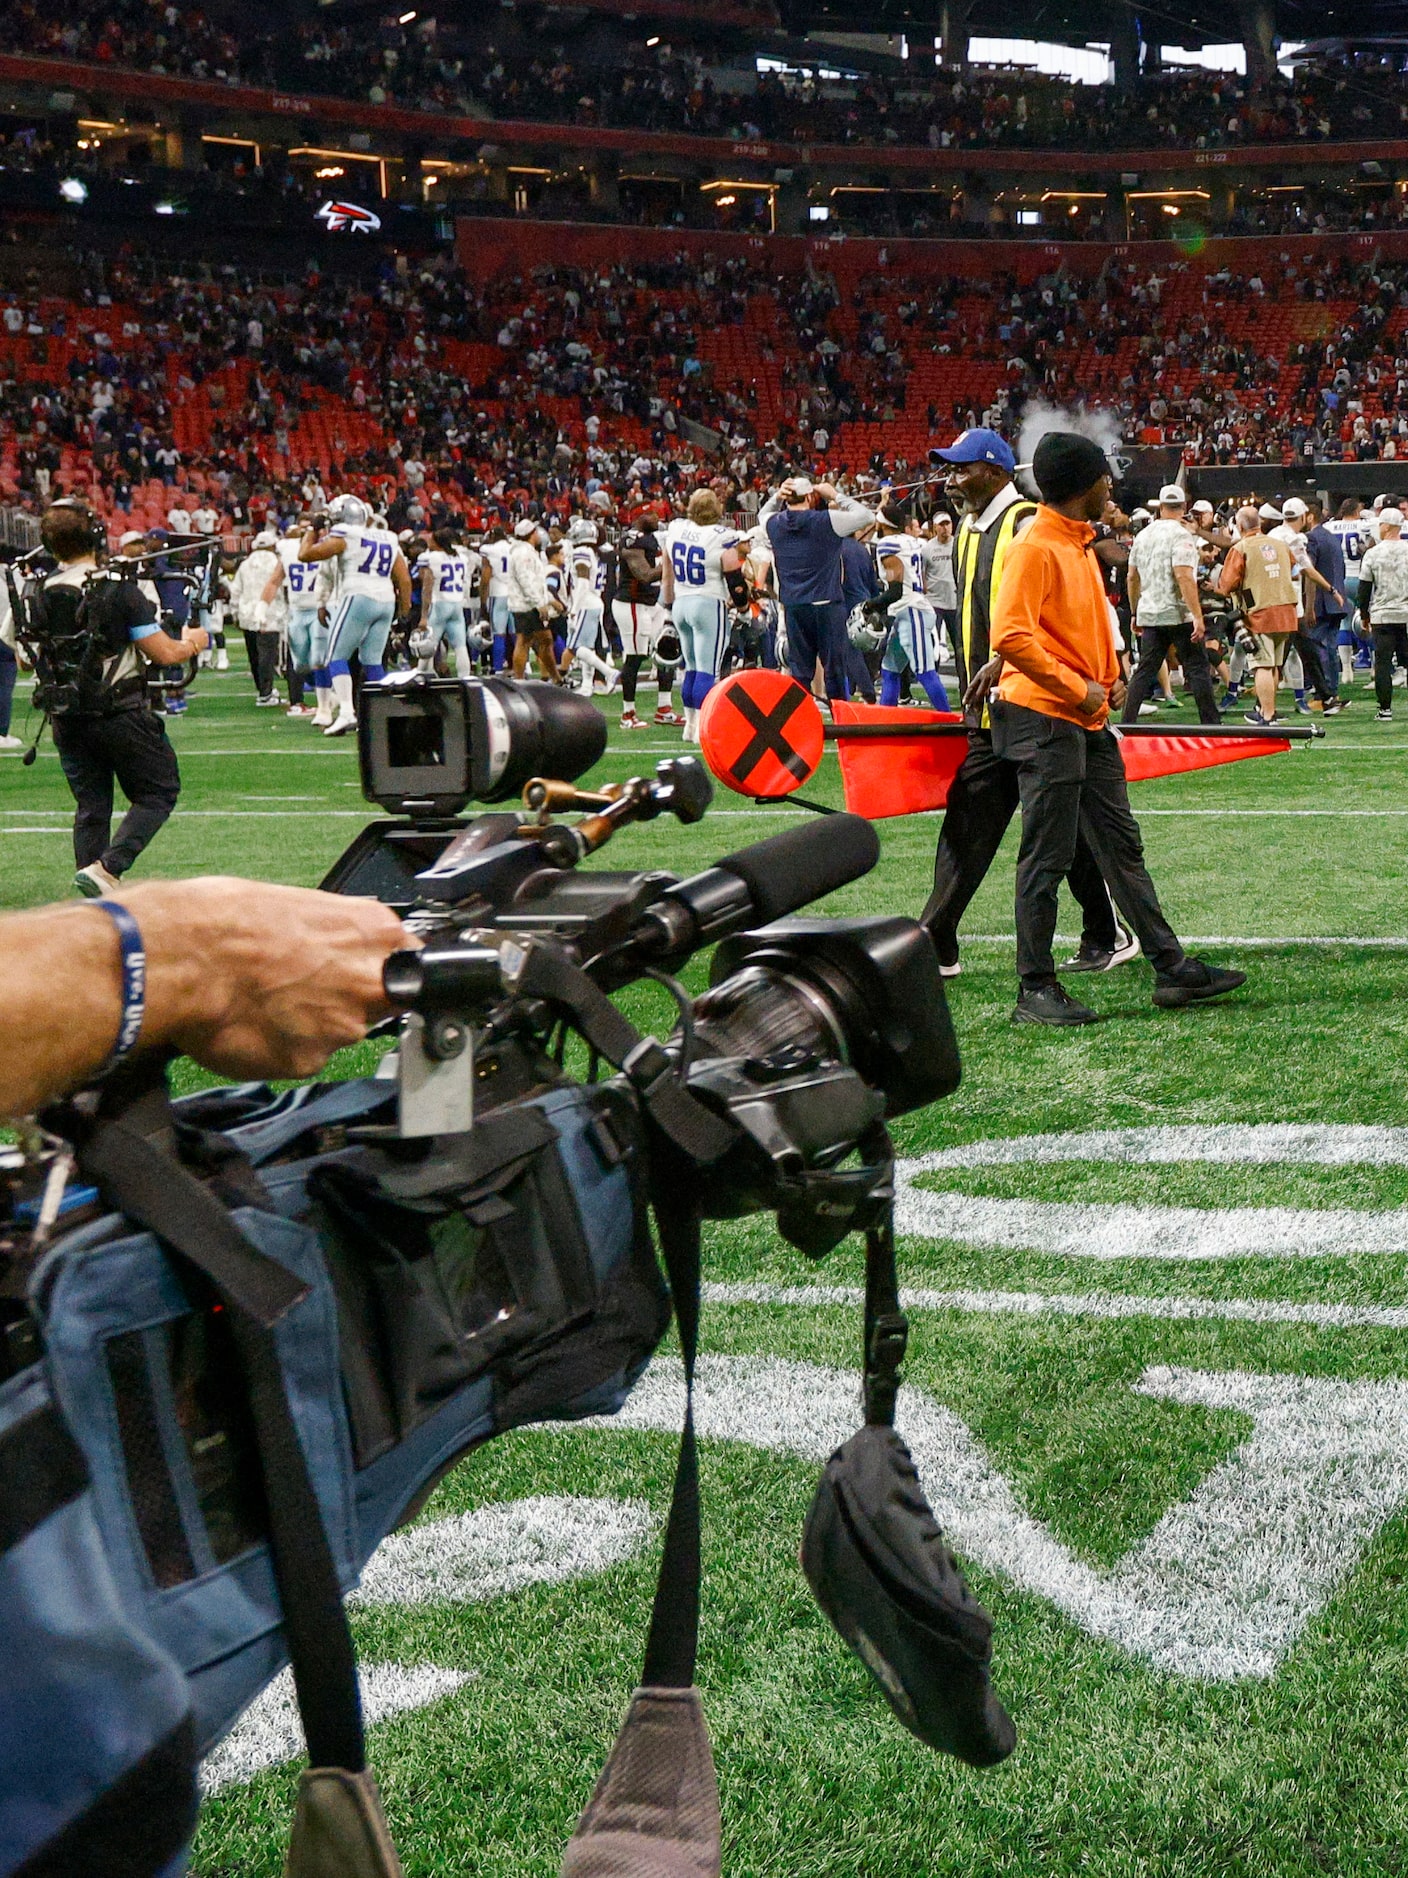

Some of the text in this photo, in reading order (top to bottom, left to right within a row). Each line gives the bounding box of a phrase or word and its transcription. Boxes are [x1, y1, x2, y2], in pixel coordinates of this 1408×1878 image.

[1304, 445, 1313, 455] 21
[680, 529, 702, 542] BASS
[1333, 522, 1358, 531] MARTIN
[357, 538, 393, 577] 78
[672, 542, 706, 586] 66
[288, 563, 320, 592] 67
[439, 563, 465, 592] 23
